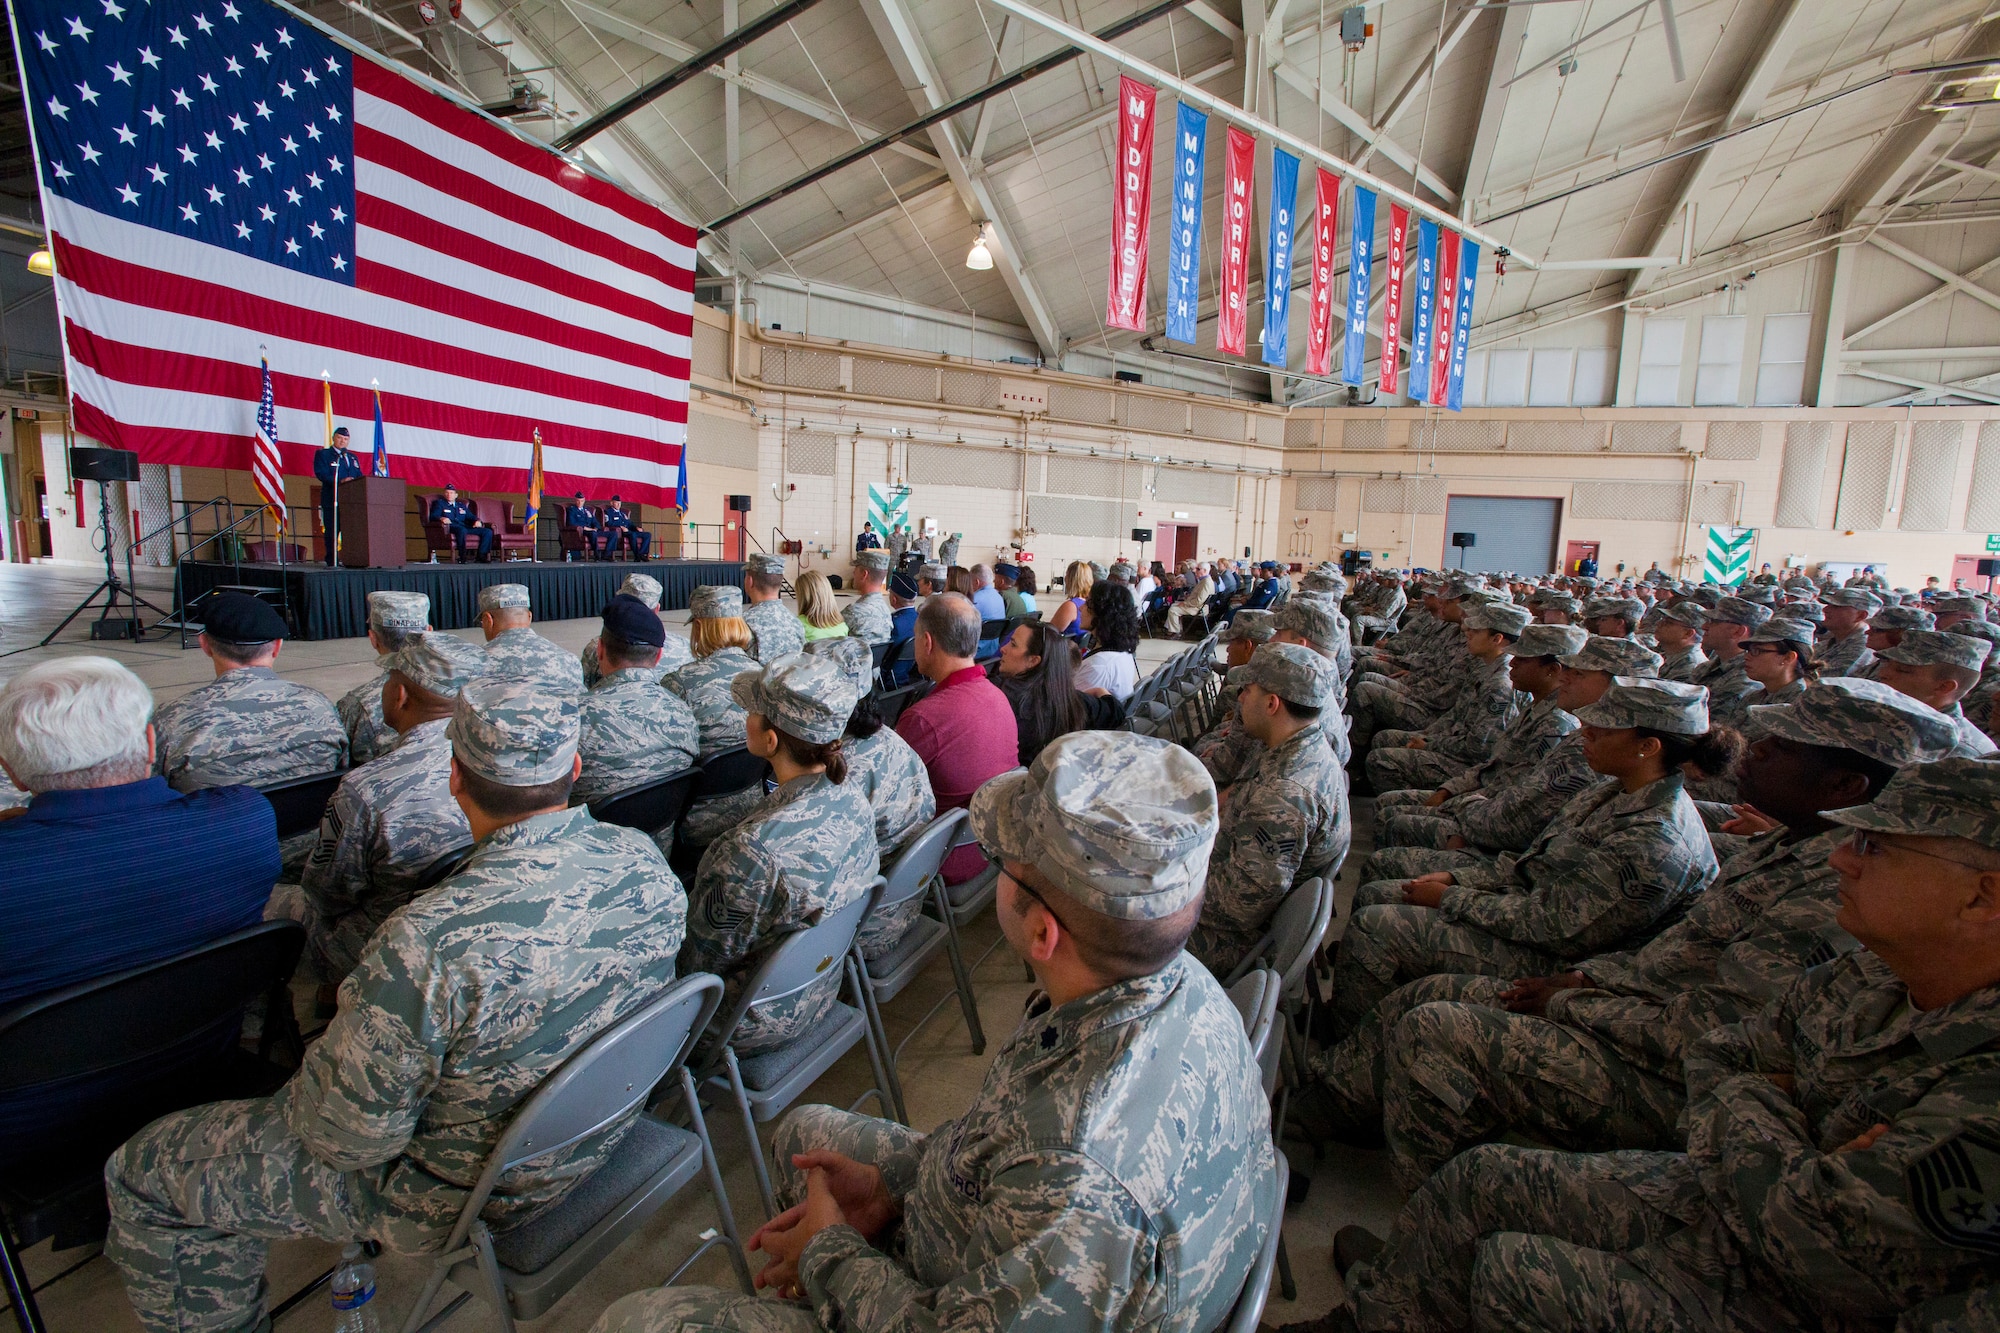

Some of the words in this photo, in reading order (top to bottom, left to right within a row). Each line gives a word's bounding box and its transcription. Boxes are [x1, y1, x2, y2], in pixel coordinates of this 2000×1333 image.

[1120, 96, 1145, 317] MIDDLESEX
[1178, 131, 1198, 318] MONMOUTH
[1229, 177, 1245, 309] MORRIS
[1272, 208, 1288, 312] OCEAN
[1316, 203, 1331, 344] PASSAIC
[1352, 241, 1367, 335] SALEM
[1386, 227, 1402, 374] SOMERSET
[1416, 258, 1430, 364] SUSSEX
[1439, 277, 1451, 362] UNION
[1453, 276, 1473, 377] WARREN
